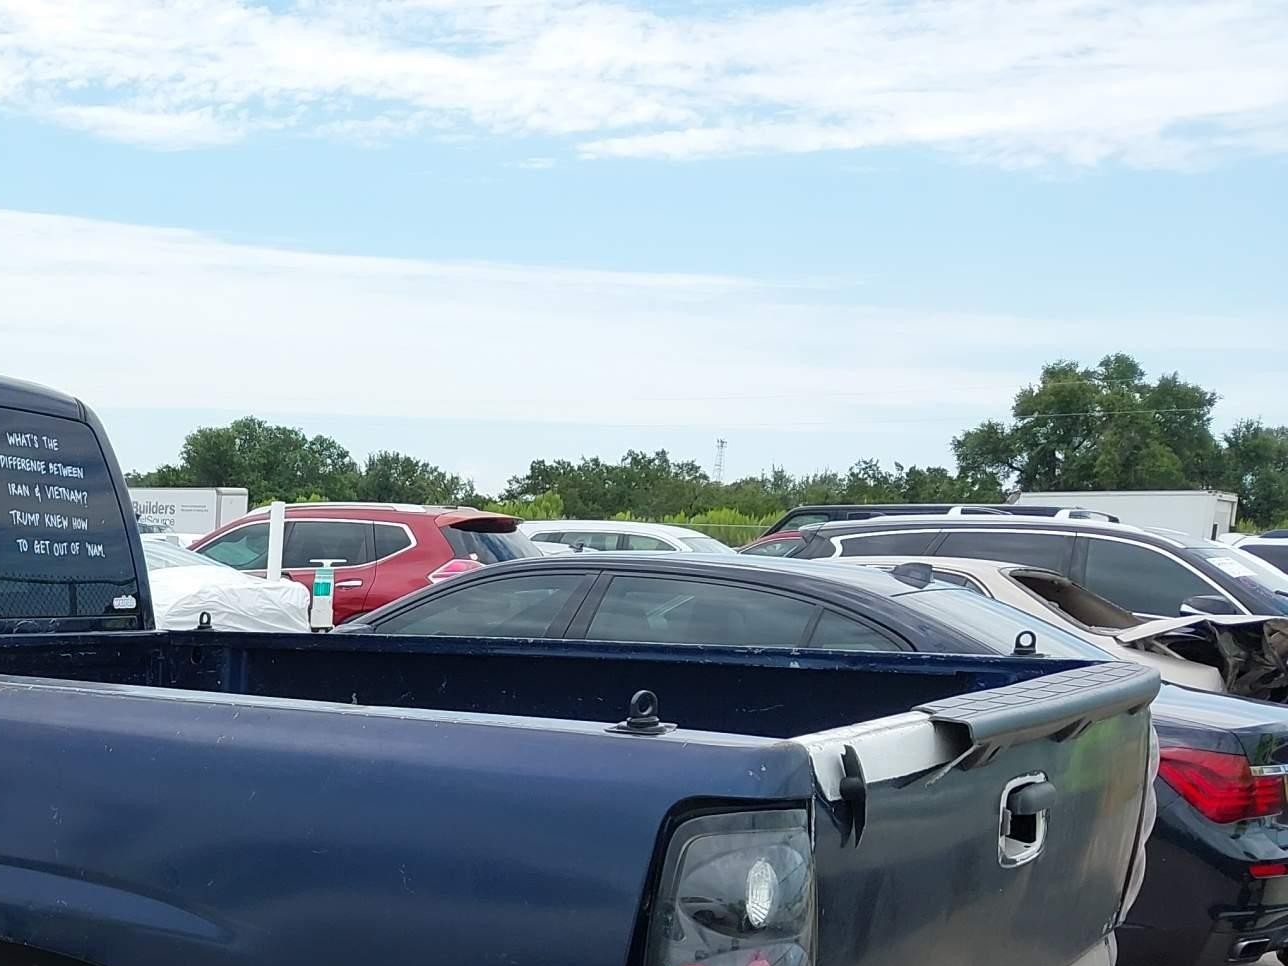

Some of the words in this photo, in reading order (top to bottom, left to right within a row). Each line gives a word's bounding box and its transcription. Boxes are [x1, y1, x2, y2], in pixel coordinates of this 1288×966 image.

[6, 432, 39, 449] WHAT'S
[42, 436, 60, 451] THE
[0, 454, 47, 475] DIFFERENCE
[49, 463, 84, 479] BETWEEN
[8, 483, 30, 497] IRAN
[34, 484, 42, 503] &
[45, 485, 88, 508] VIETNAM?
[132, 501, 176, 515] Builders
[9, 510, 40, 527] TRUMP
[44, 513, 69, 530] KNEW
[72, 517, 88, 531] HOW
[16, 539, 29, 553] TO
[34, 540, 51, 555] GET
[53, 543, 68, 557] OUT
[71, 542, 80, 554] OF
